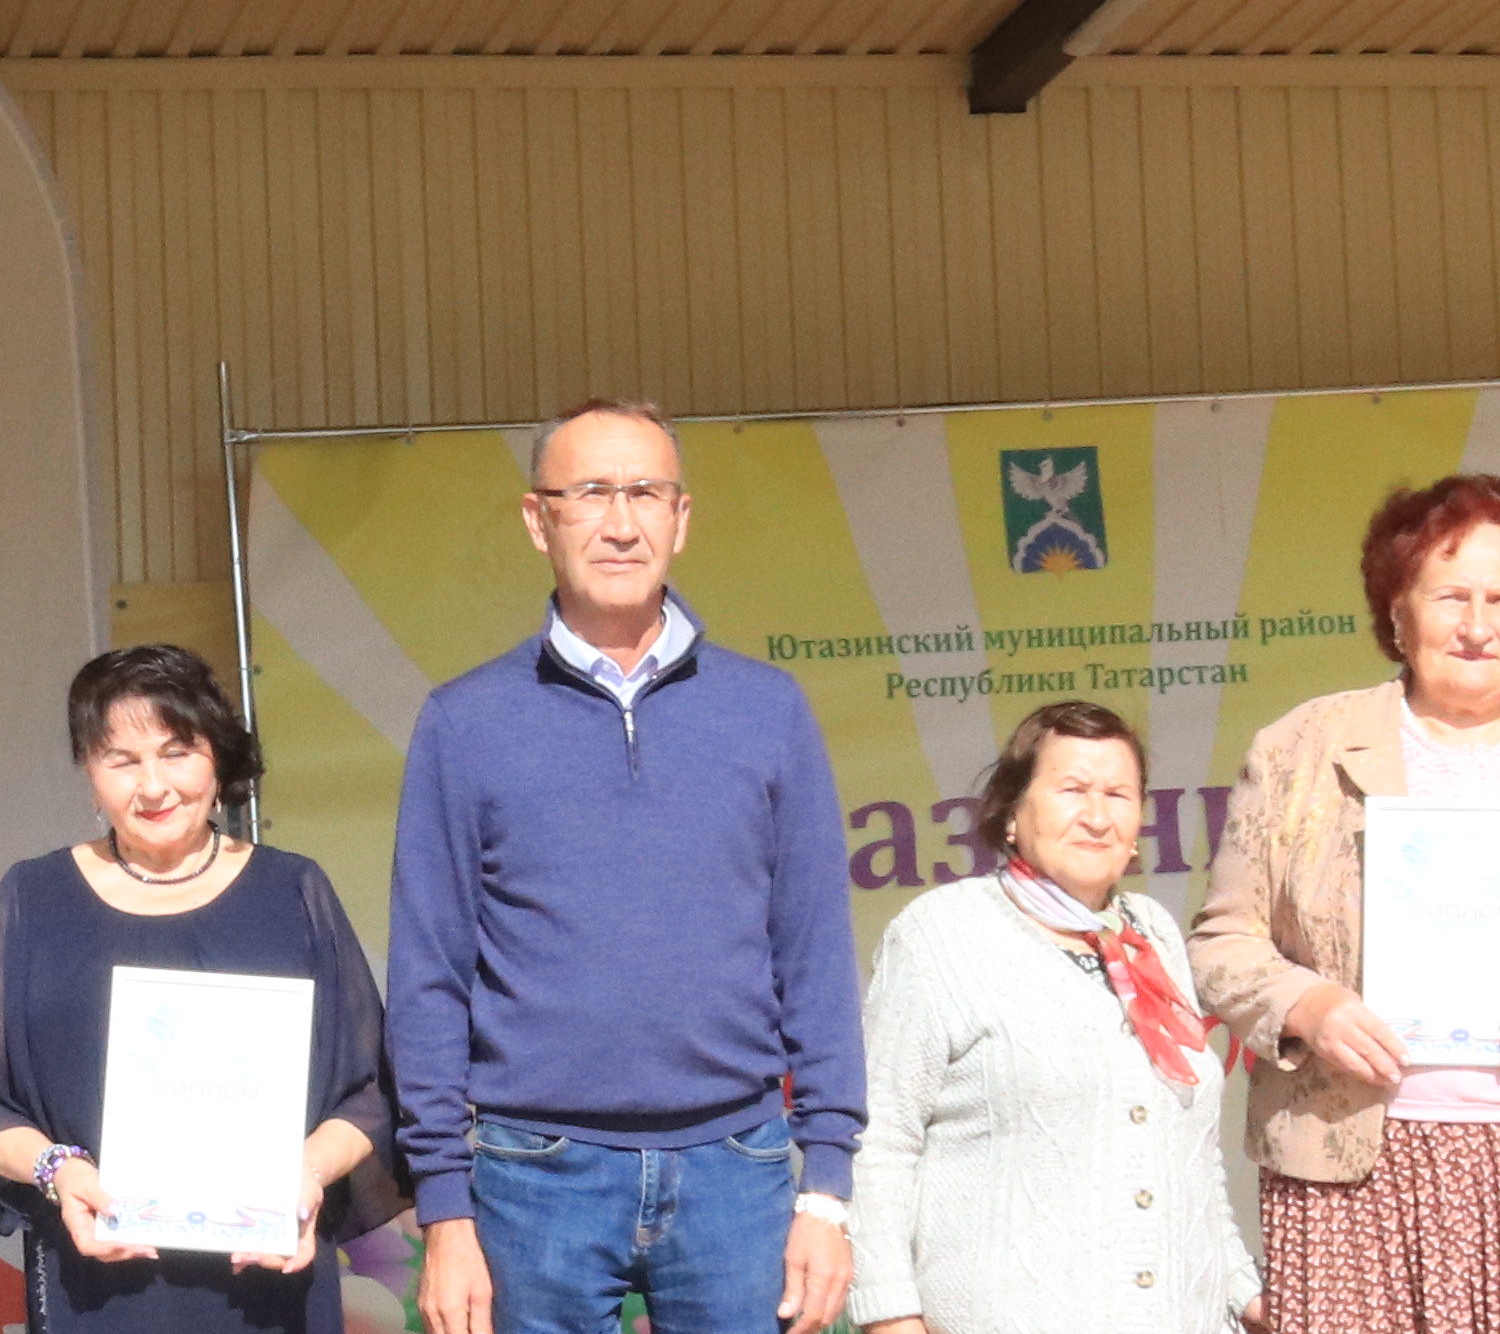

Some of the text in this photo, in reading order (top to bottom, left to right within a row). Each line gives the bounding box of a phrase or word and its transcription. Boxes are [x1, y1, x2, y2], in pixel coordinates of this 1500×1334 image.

[766, 609, 1358, 661] Ютазинский муниципальный район
[885, 663, 1250, 700] Республики Татарстан
